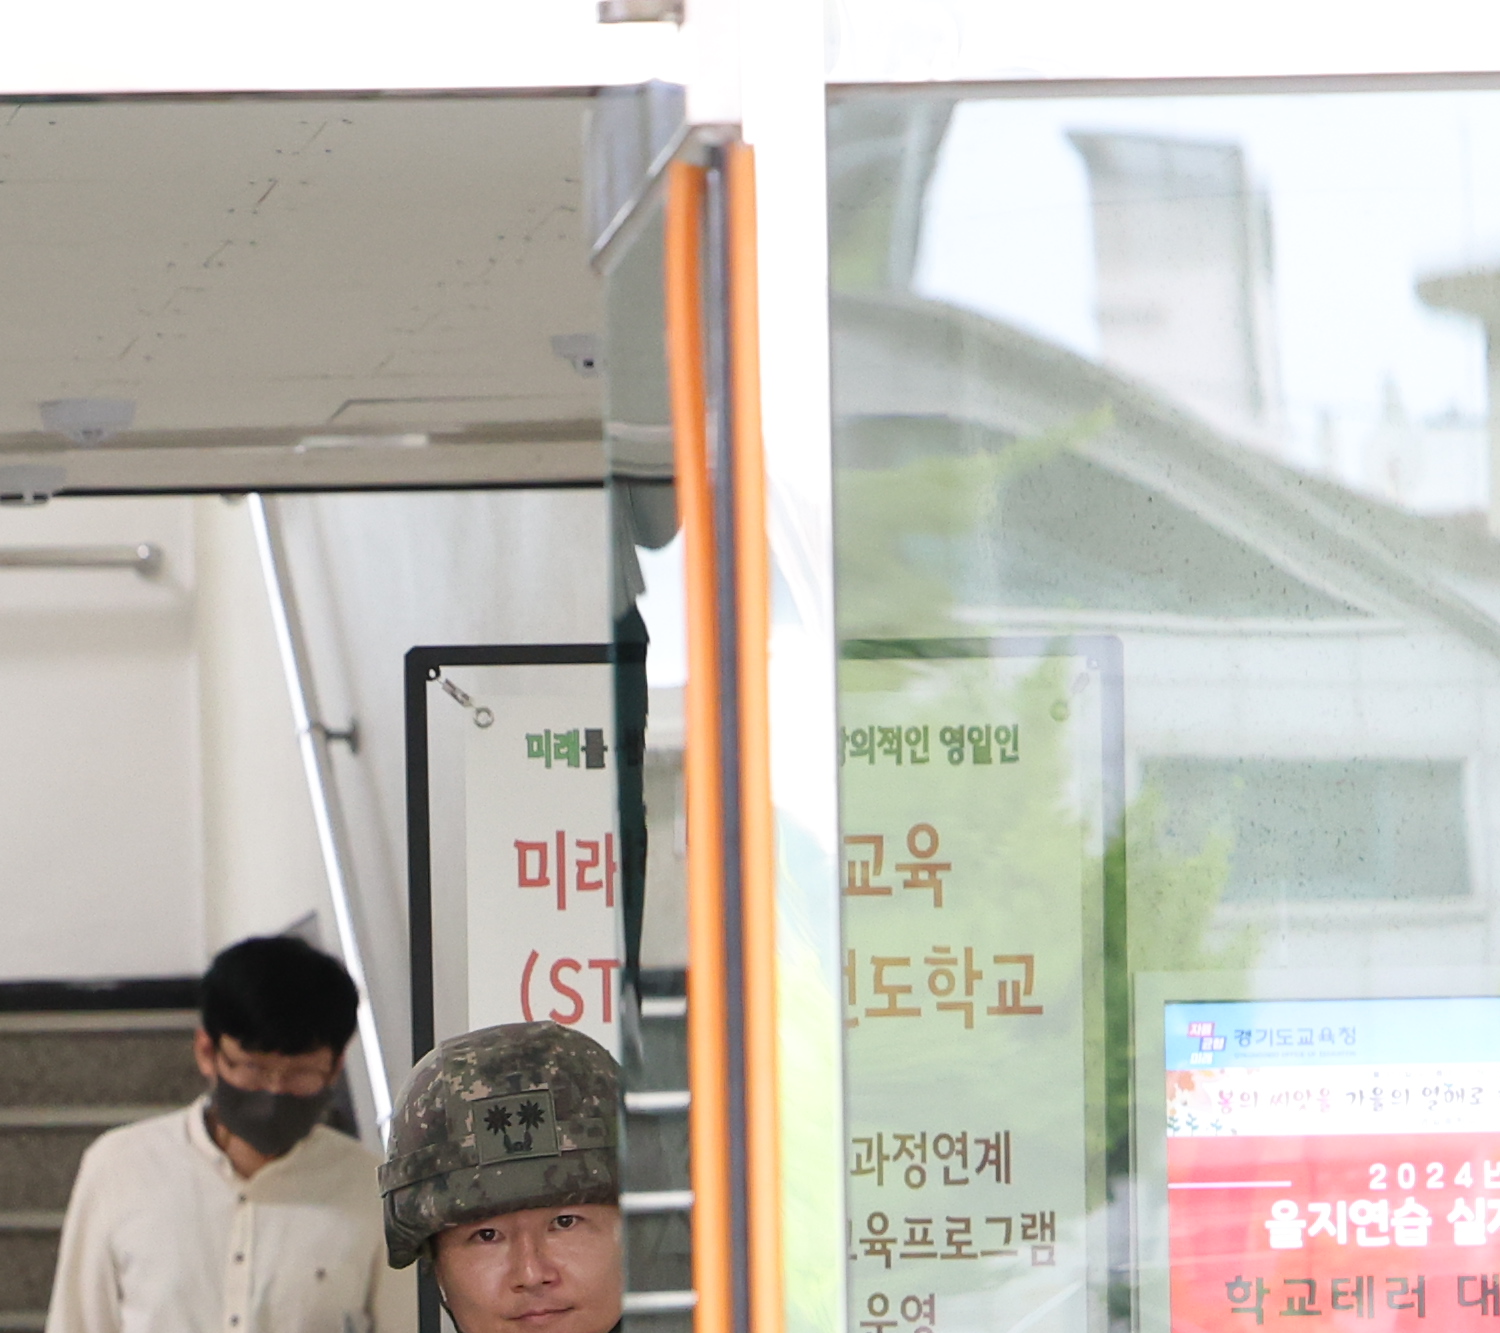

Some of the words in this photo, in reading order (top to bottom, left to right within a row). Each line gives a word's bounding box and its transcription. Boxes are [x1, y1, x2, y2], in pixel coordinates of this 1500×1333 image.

[939, 723, 1020, 766] 영일인
[843, 822, 953, 909] 교육
[1234, 1026, 1357, 1049] 경기도교육청
[1345, 1085, 1411, 1113] 가을의
[849, 1130, 1013, 1190] 과정연계
[848, 1210, 1057, 1269] 육프로그램
[1263, 1196, 1432, 1250] 을지연습
[1224, 1271, 1428, 1327] 학교테러
